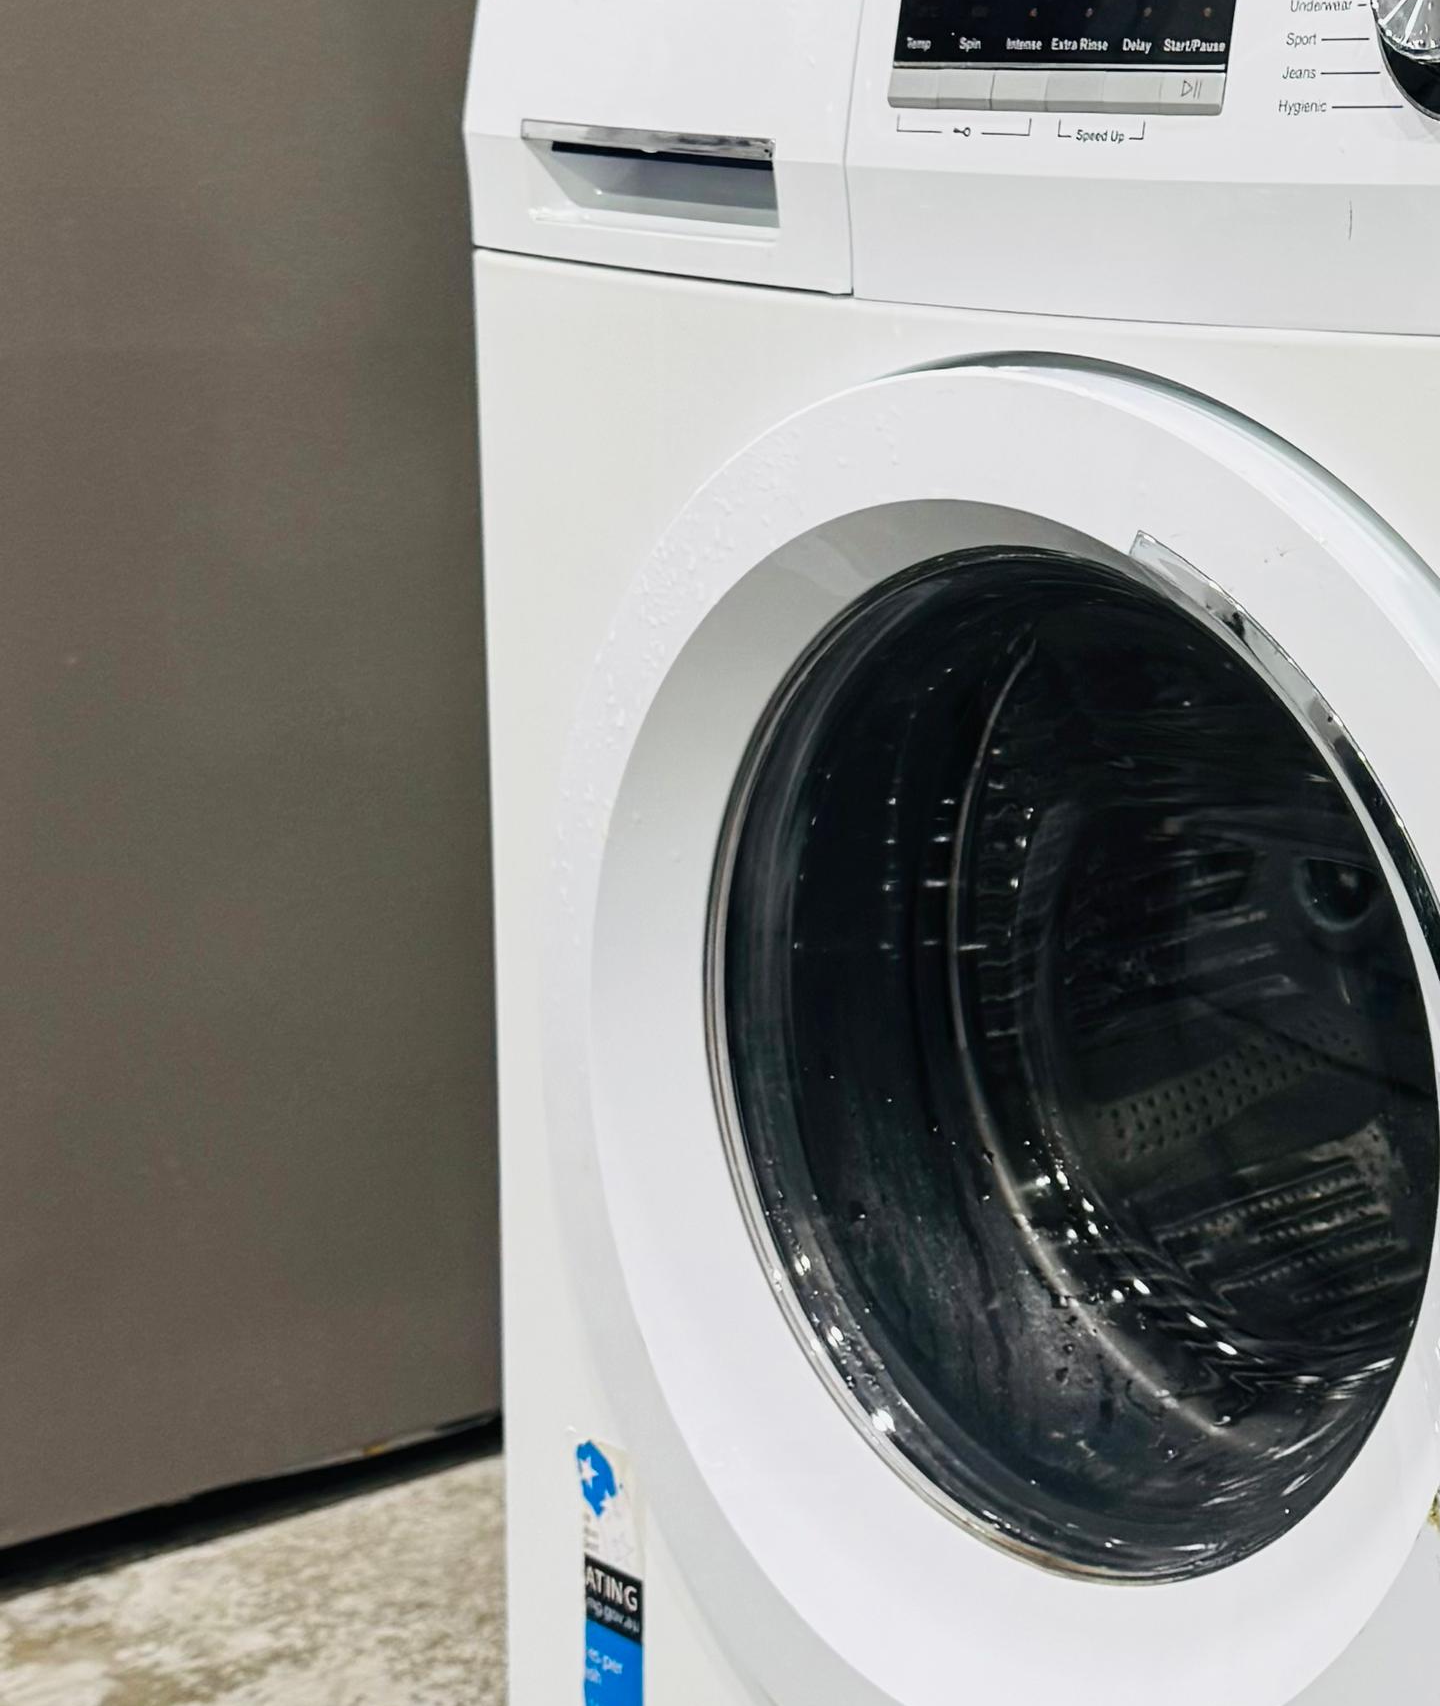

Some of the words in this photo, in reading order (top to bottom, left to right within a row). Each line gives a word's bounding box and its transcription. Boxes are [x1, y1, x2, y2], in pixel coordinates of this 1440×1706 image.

[1290, 0, 1353, 12] Underwear
[906, 36, 932, 52] Temp
[959, 36, 982, 52] Spin
[1006, 37, 1043, 51] Intense
[1051, 37, 1078, 51] Extra
[1079, 37, 1108, 51] Rinse
[1122, 37, 1152, 55] Delay
[1163, 38, 1226, 53] Start/Pause
[1286, 32, 1317, 48] Sport
[1282, 66, 1317, 79] Jeans
[1278, 99, 1327, 116] Hygienic
[1076, 129, 1108, 143] Speed
[1111, 130, 1125, 144] Up
